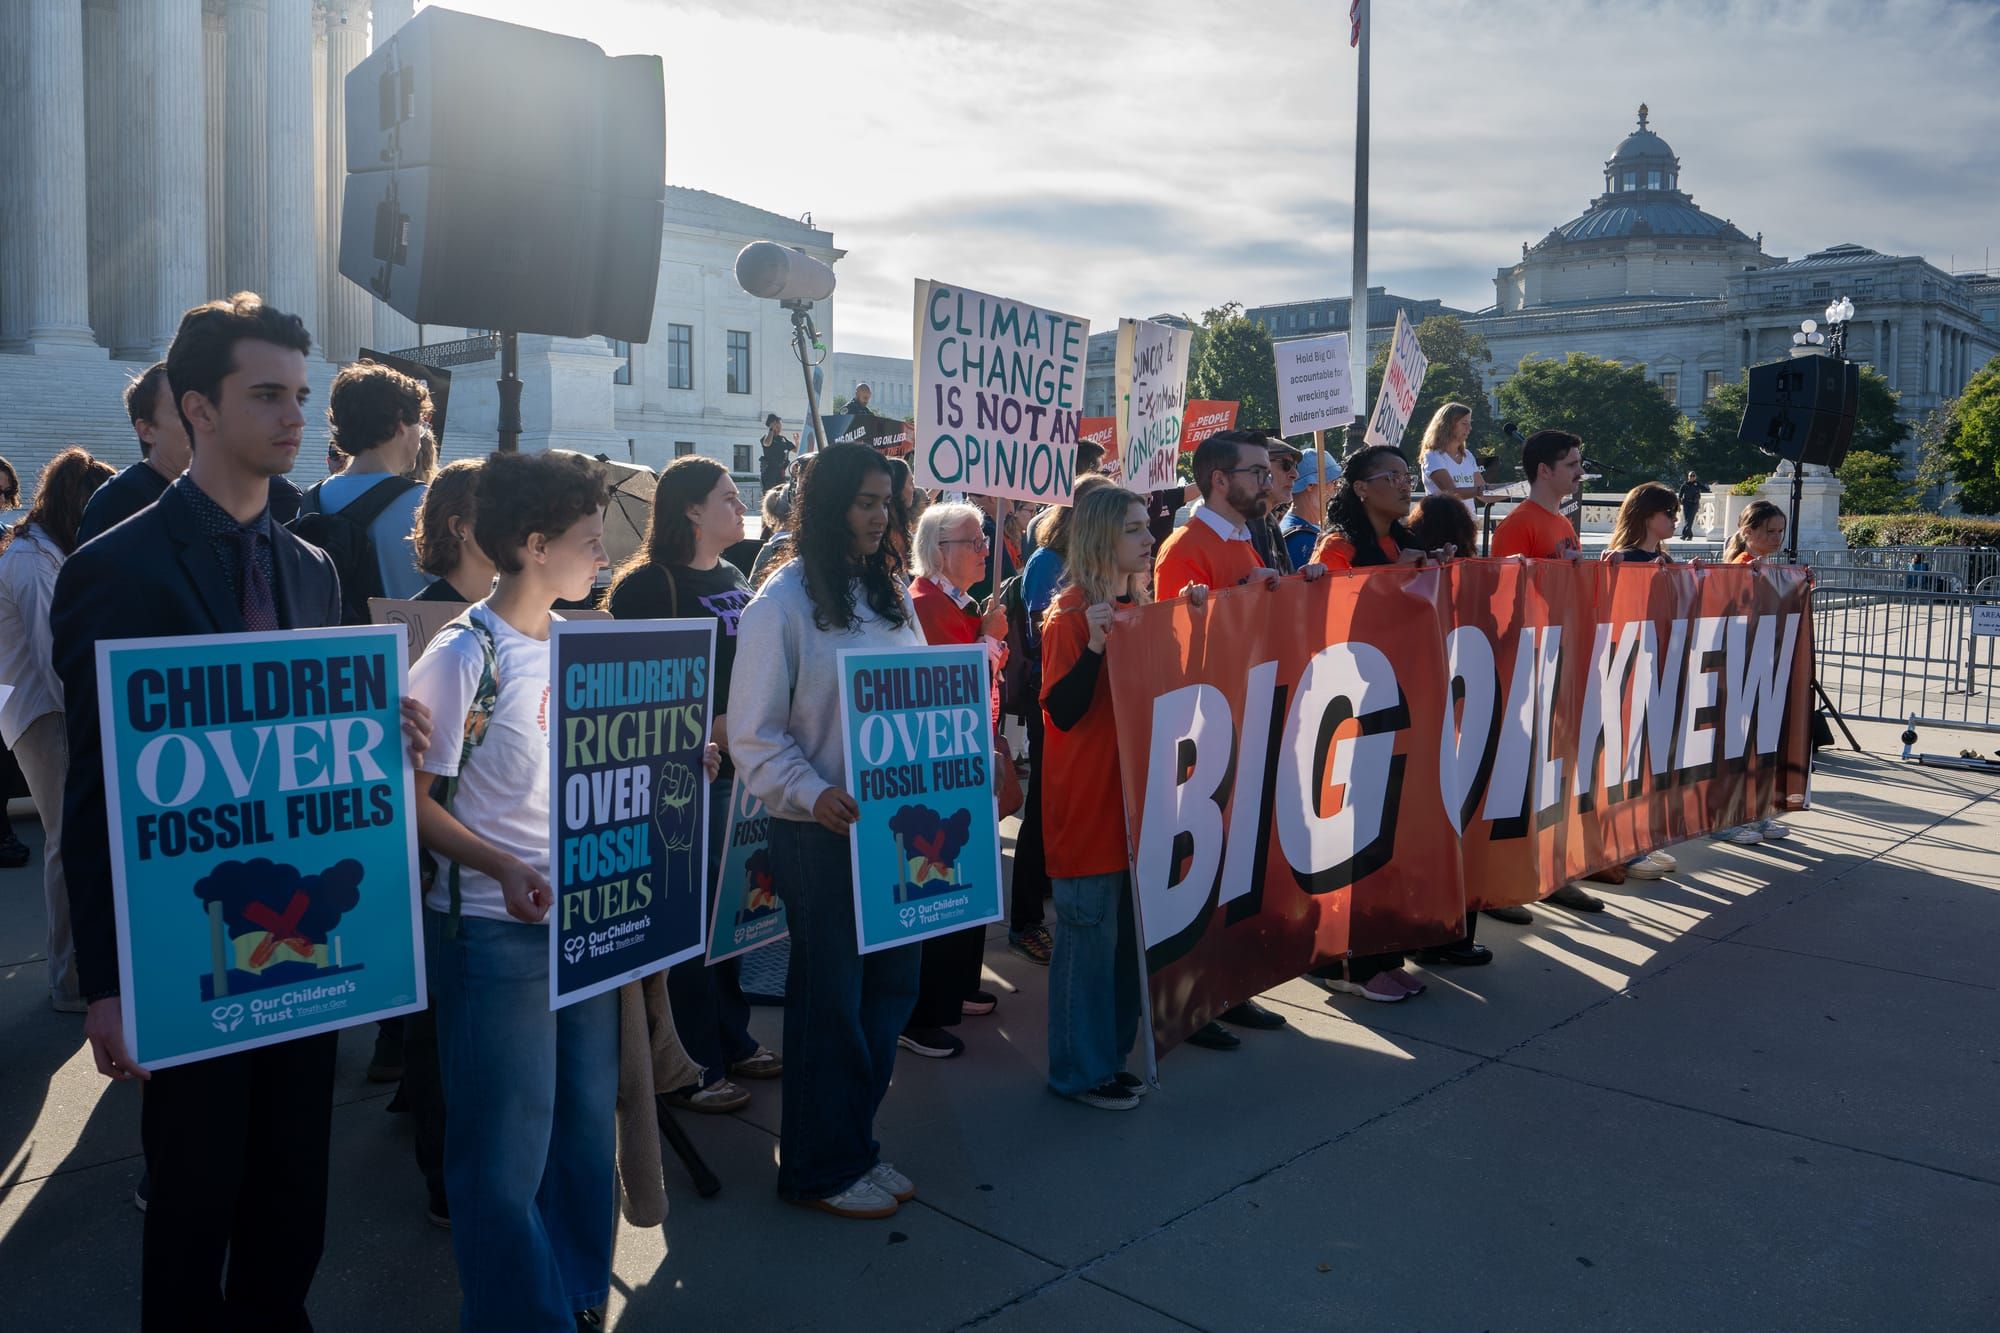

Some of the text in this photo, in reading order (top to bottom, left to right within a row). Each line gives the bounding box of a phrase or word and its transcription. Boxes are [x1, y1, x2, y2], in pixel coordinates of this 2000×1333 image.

[930, 288, 1082, 363] CLIMATE
[1167, 335, 1174, 363] &
[937, 337, 1075, 409] CHANGE
[1290, 369, 1343, 385] accountable for
[1296, 350, 1336, 364] Hold Big Oil
[935, 383, 1083, 444] IS NOT AN
[1196, 410, 1230, 427] PEOPLE
[1290, 409, 1325, 423] children's
[1297, 388, 1340, 403] wrecking our
[1191, 429, 1212, 442] BIG
[928, 434, 1075, 497] OPINION
[127, 654, 387, 733] CHILDREN
[565, 656, 705, 711] CHILDREN'S
[854, 664, 980, 713] CHILDREN
[565, 703, 704, 768] RIGHTS
[859, 708, 981, 766] OVER
[136, 717, 388, 807] OVER
[860, 756, 985, 801] FOSSIL FUELS
[1137, 613, 1802, 958] BIG OIL KNEW
[565, 764, 650, 830] OVER
[136, 784, 394, 861] FOSSIL FUELS
[564, 822, 652, 886] FOSSIL
[562, 872, 653, 931] FUELS
[918, 904, 933, 914] Our
[933, 895, 969, 911] Children's
[919, 911, 940, 925] Trust
[588, 914, 651, 944] Our Children's
[588, 940, 614, 959] Trust
[250, 980, 356, 1012] Our Children's
[251, 1007, 294, 1026] Trust
